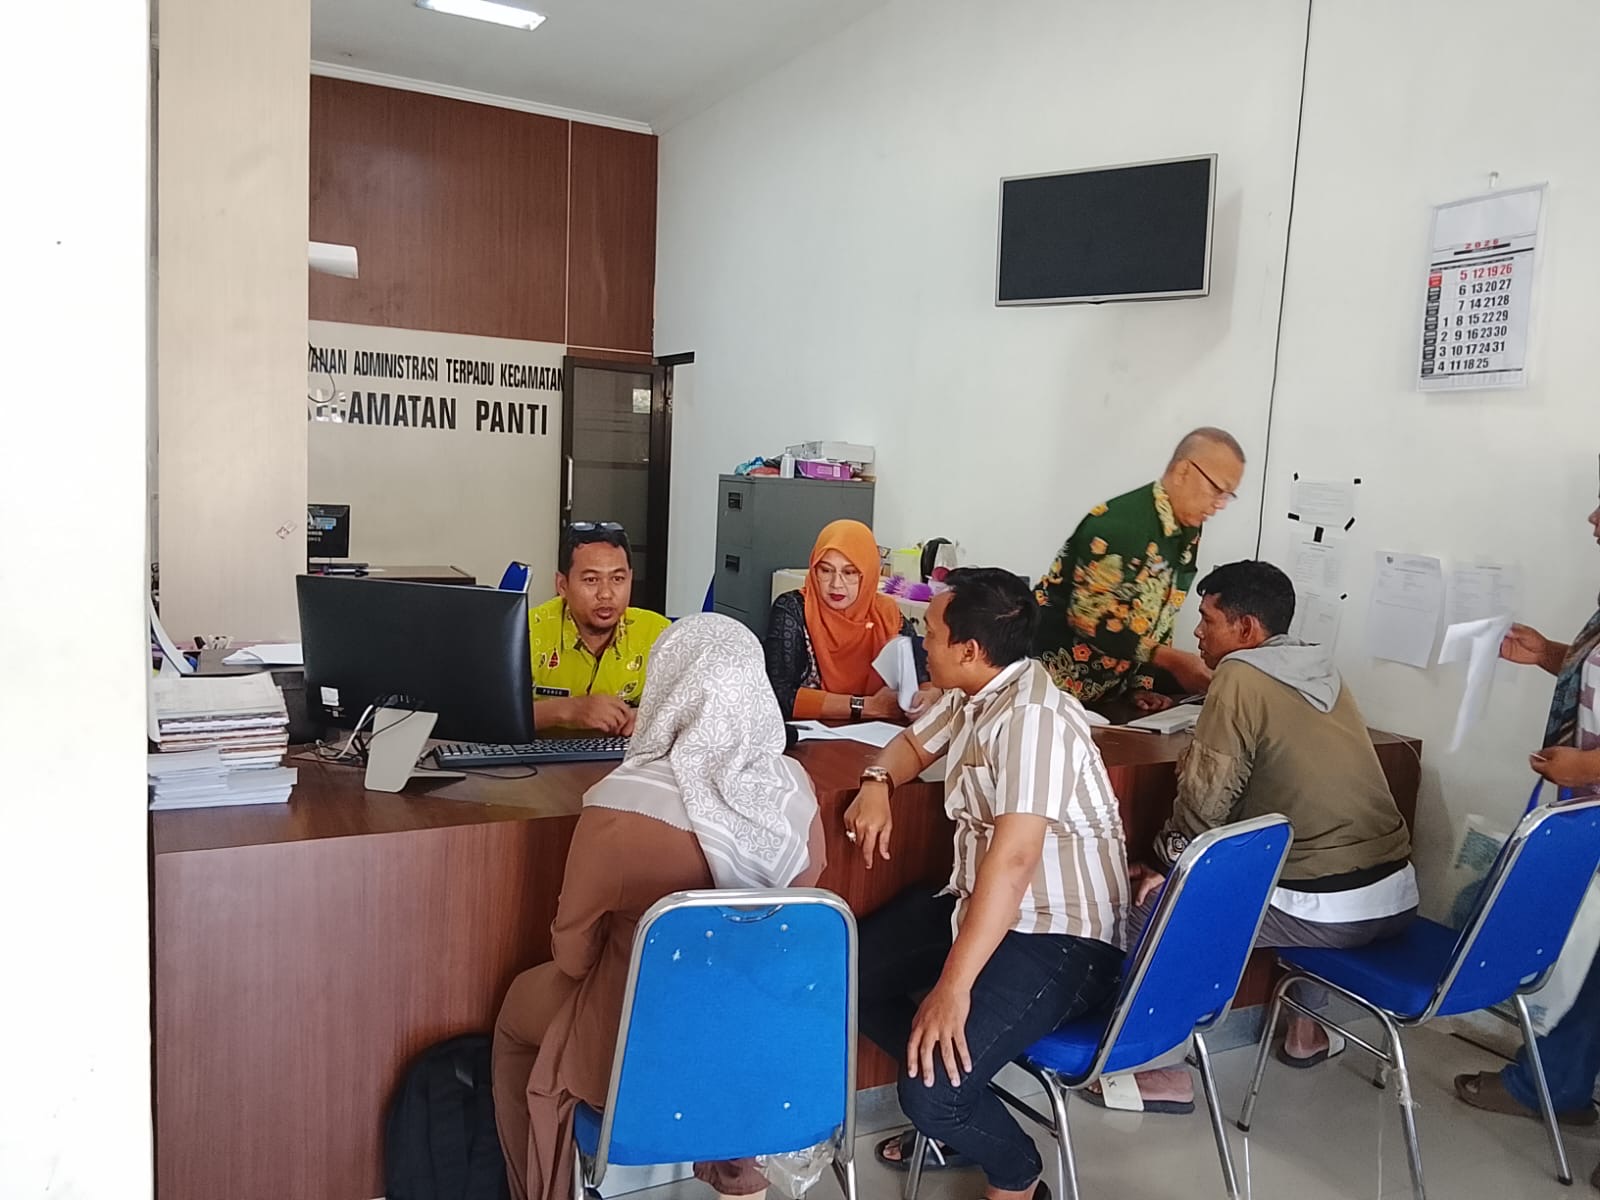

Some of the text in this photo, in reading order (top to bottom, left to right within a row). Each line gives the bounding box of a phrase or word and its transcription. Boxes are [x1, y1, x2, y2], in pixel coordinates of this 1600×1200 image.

[1460, 263, 1513, 280] 5 12 19 26
[1459, 278, 1512, 295] 6 13 20 27
[1458, 294, 1509, 311] 7 14 21 28
[1443, 316, 1448, 327] 1
[1456, 315, 1463, 326] 8
[1468, 313, 1480, 324] 15
[1482, 311, 1494, 323] 22
[1496, 309, 1509, 321] 29
[1441, 331, 1448, 342] 2
[1455, 330, 1462, 341] 9
[1467, 328, 1479, 339] 16
[1480, 326, 1492, 338] 23
[1493, 325, 1507, 337] 30
[1439, 346, 1446, 357] 3
[1452, 345, 1463, 356] 10
[1466, 343, 1477, 355] 17
[1479, 342, 1490, 353] 24
[1492, 340, 1505, 352] 31
[353, 350, 438, 382] ADMINISTRASI
[446, 358, 494, 386] TERPADU
[500, 363, 564, 392] KECAMATAN
[1438, 361, 1445, 372] 4
[1450, 360, 1461, 370] 11
[1463, 358, 1475, 370] 18
[1476, 357, 1489, 369] 25
[308, 390, 547, 435] AMATAN PANTI
